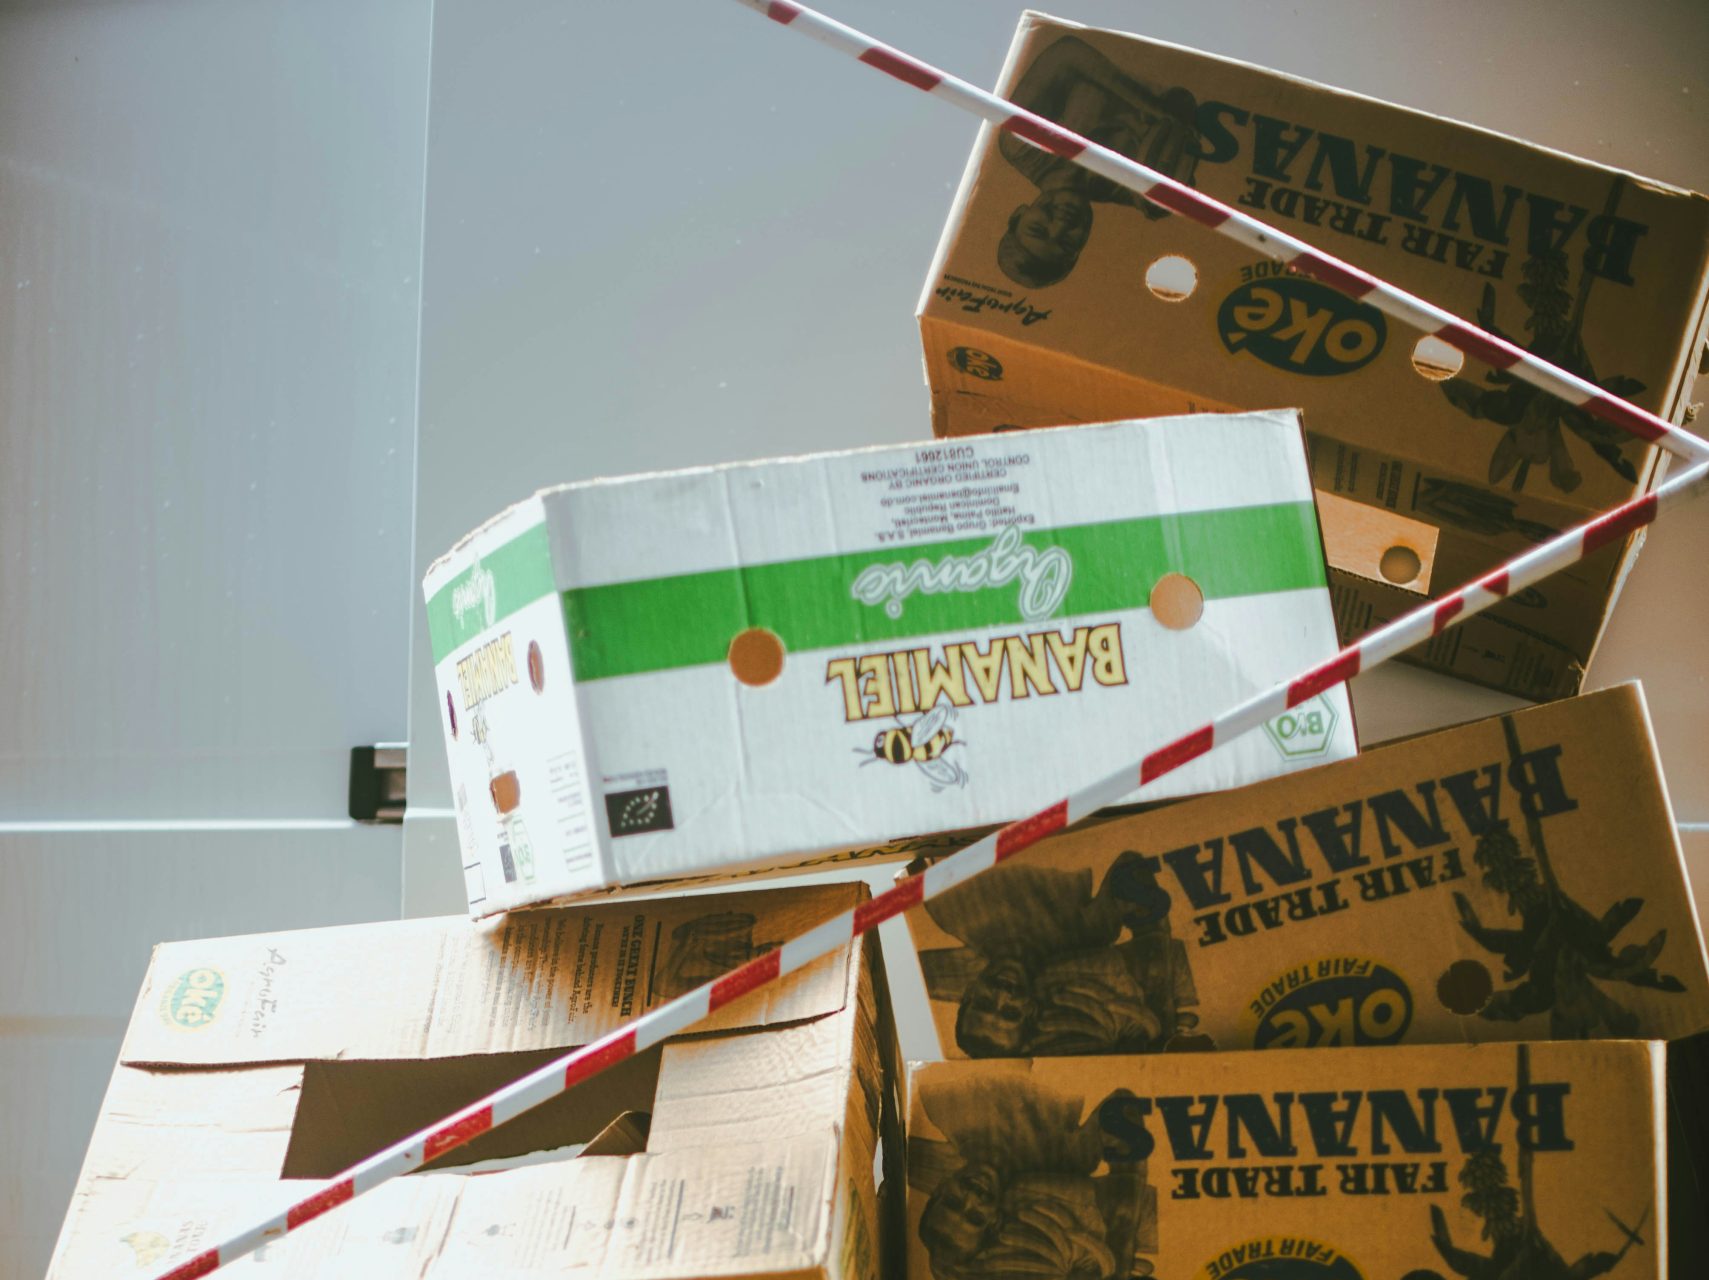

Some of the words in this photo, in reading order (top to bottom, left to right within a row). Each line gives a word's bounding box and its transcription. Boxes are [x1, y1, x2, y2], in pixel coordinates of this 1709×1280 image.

[1186, 100, 1650, 286] BANANAS
[1239, 177, 1392, 245] TRADE
[1403, 222, 1508, 279] FAIR
[936, 287, 1052, 326] AgroFair
[1228, 287, 1378, 363] oké
[860, 465, 945, 482] CERTIFICATIONS
[915, 445, 974, 464] CU812661
[947, 461, 979, 474] UNION
[984, 454, 1030, 468] CONTROL
[889, 481, 903, 490] BY
[906, 474, 952, 488] ORGANIC
[955, 468, 1007, 482] CERTIFIED
[852, 524, 1072, 622] Organic
[825, 622, 1129, 722] BANAMIEL
[1108, 744, 1578, 926] BANANAS
[1358, 849, 1466, 902] FAIR
[1193, 878, 1349, 948] TRADE
[1318, 957, 1372, 980] FAIR
[1249, 966, 1314, 1020] TRADE
[1101, 1083, 1575, 1163] BANANAS
[1171, 1164, 1327, 1200] TRADE
[1339, 1162, 1449, 1195] FAIR
[1206, 1238, 1279, 1280] TRADE
[1281, 1238, 1335, 1265] FAIR
